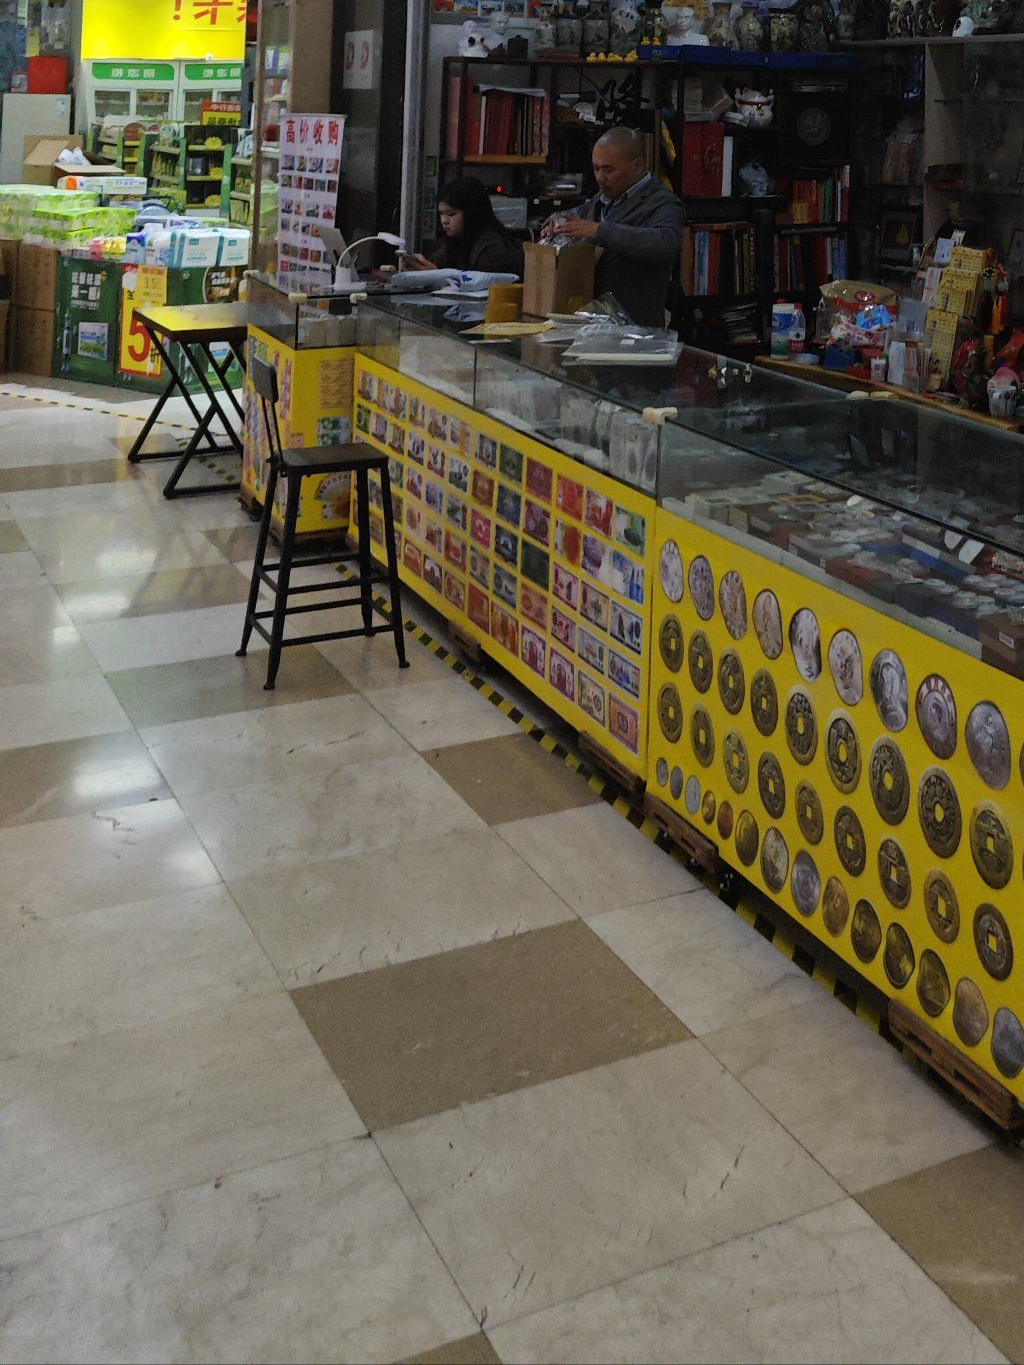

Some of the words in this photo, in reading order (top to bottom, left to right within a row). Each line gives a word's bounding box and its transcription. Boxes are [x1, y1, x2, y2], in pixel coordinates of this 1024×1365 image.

[286, 118, 340, 146] 高价收购
[128, 318, 151, 362] 5
